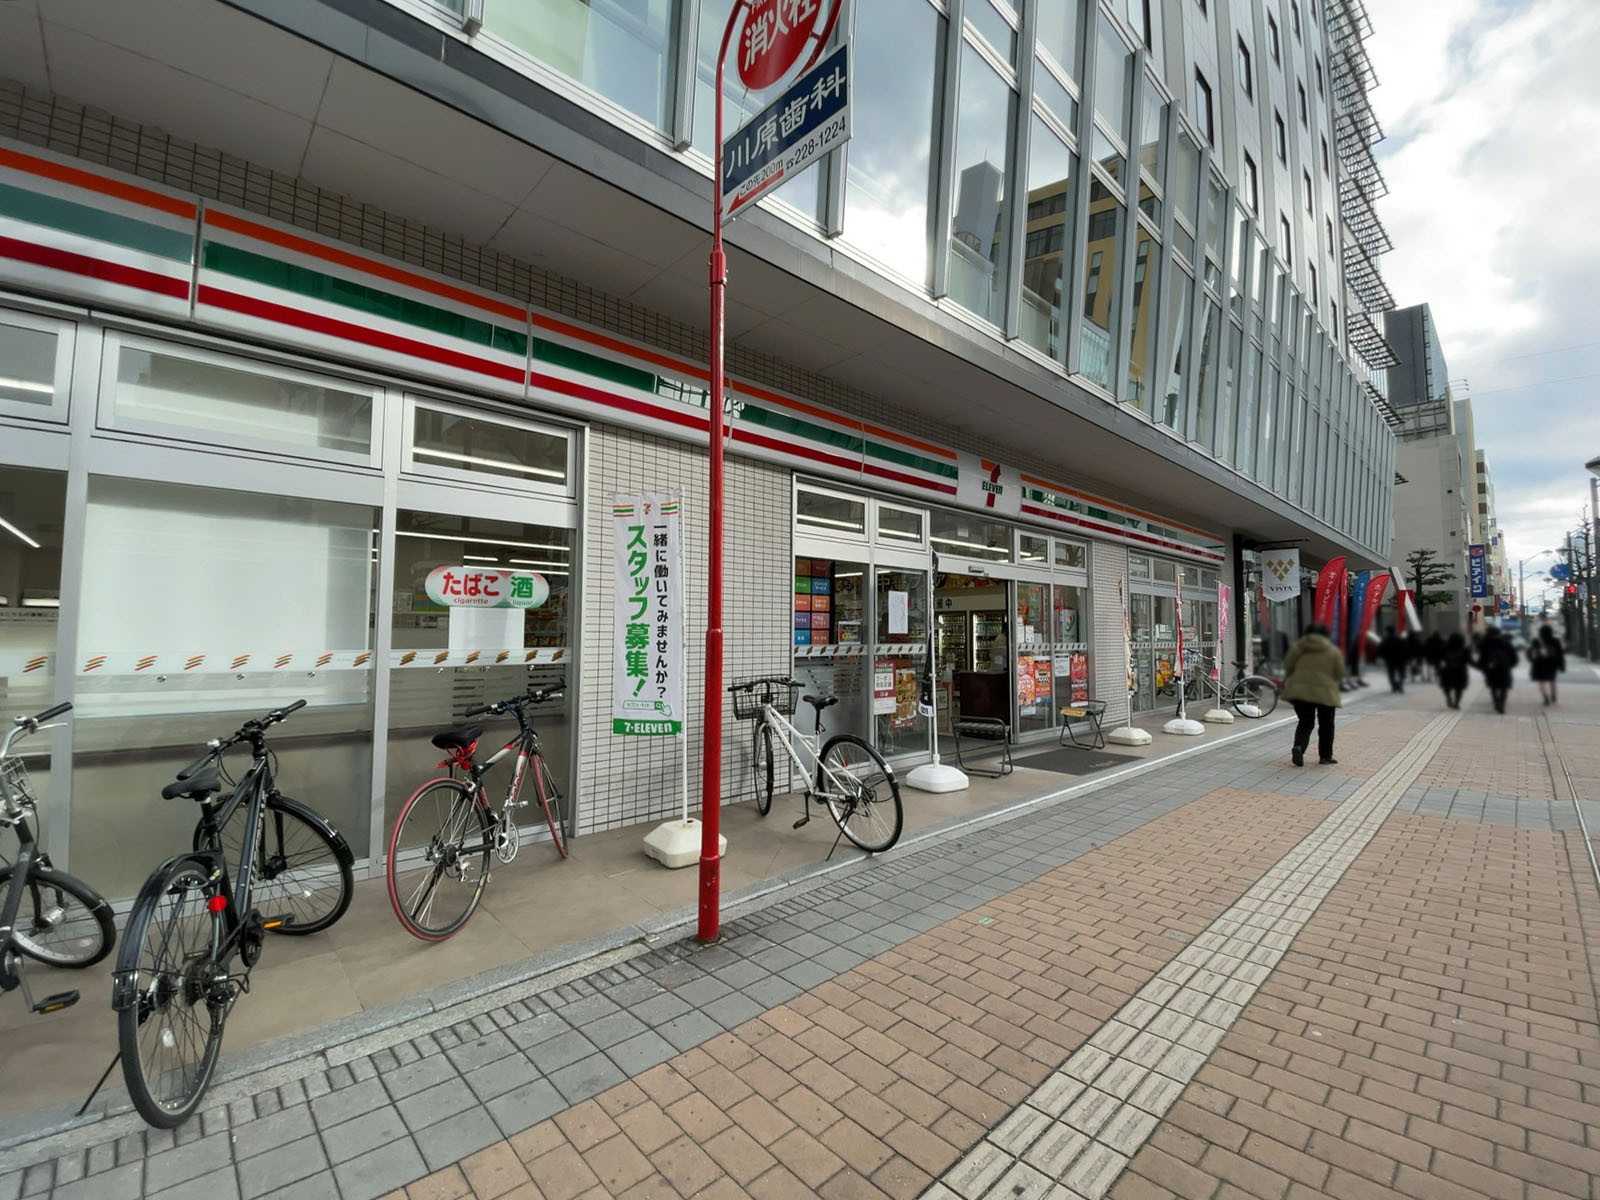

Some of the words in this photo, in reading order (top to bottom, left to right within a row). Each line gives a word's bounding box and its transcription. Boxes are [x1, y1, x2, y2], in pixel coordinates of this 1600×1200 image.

[726, 66, 846, 178] 川原歯科
[795, 116, 847, 165] 228-1224
[739, 159, 784, 197] この先200m
[442, 572, 500, 597] たばこ
[510, 576, 533, 598] 酒
[454, 597, 488, 605] cigarette
[625, 524, 650, 697] スタッフ募集！
[653, 524, 669, 699] 一緒に働いてみませんか？
